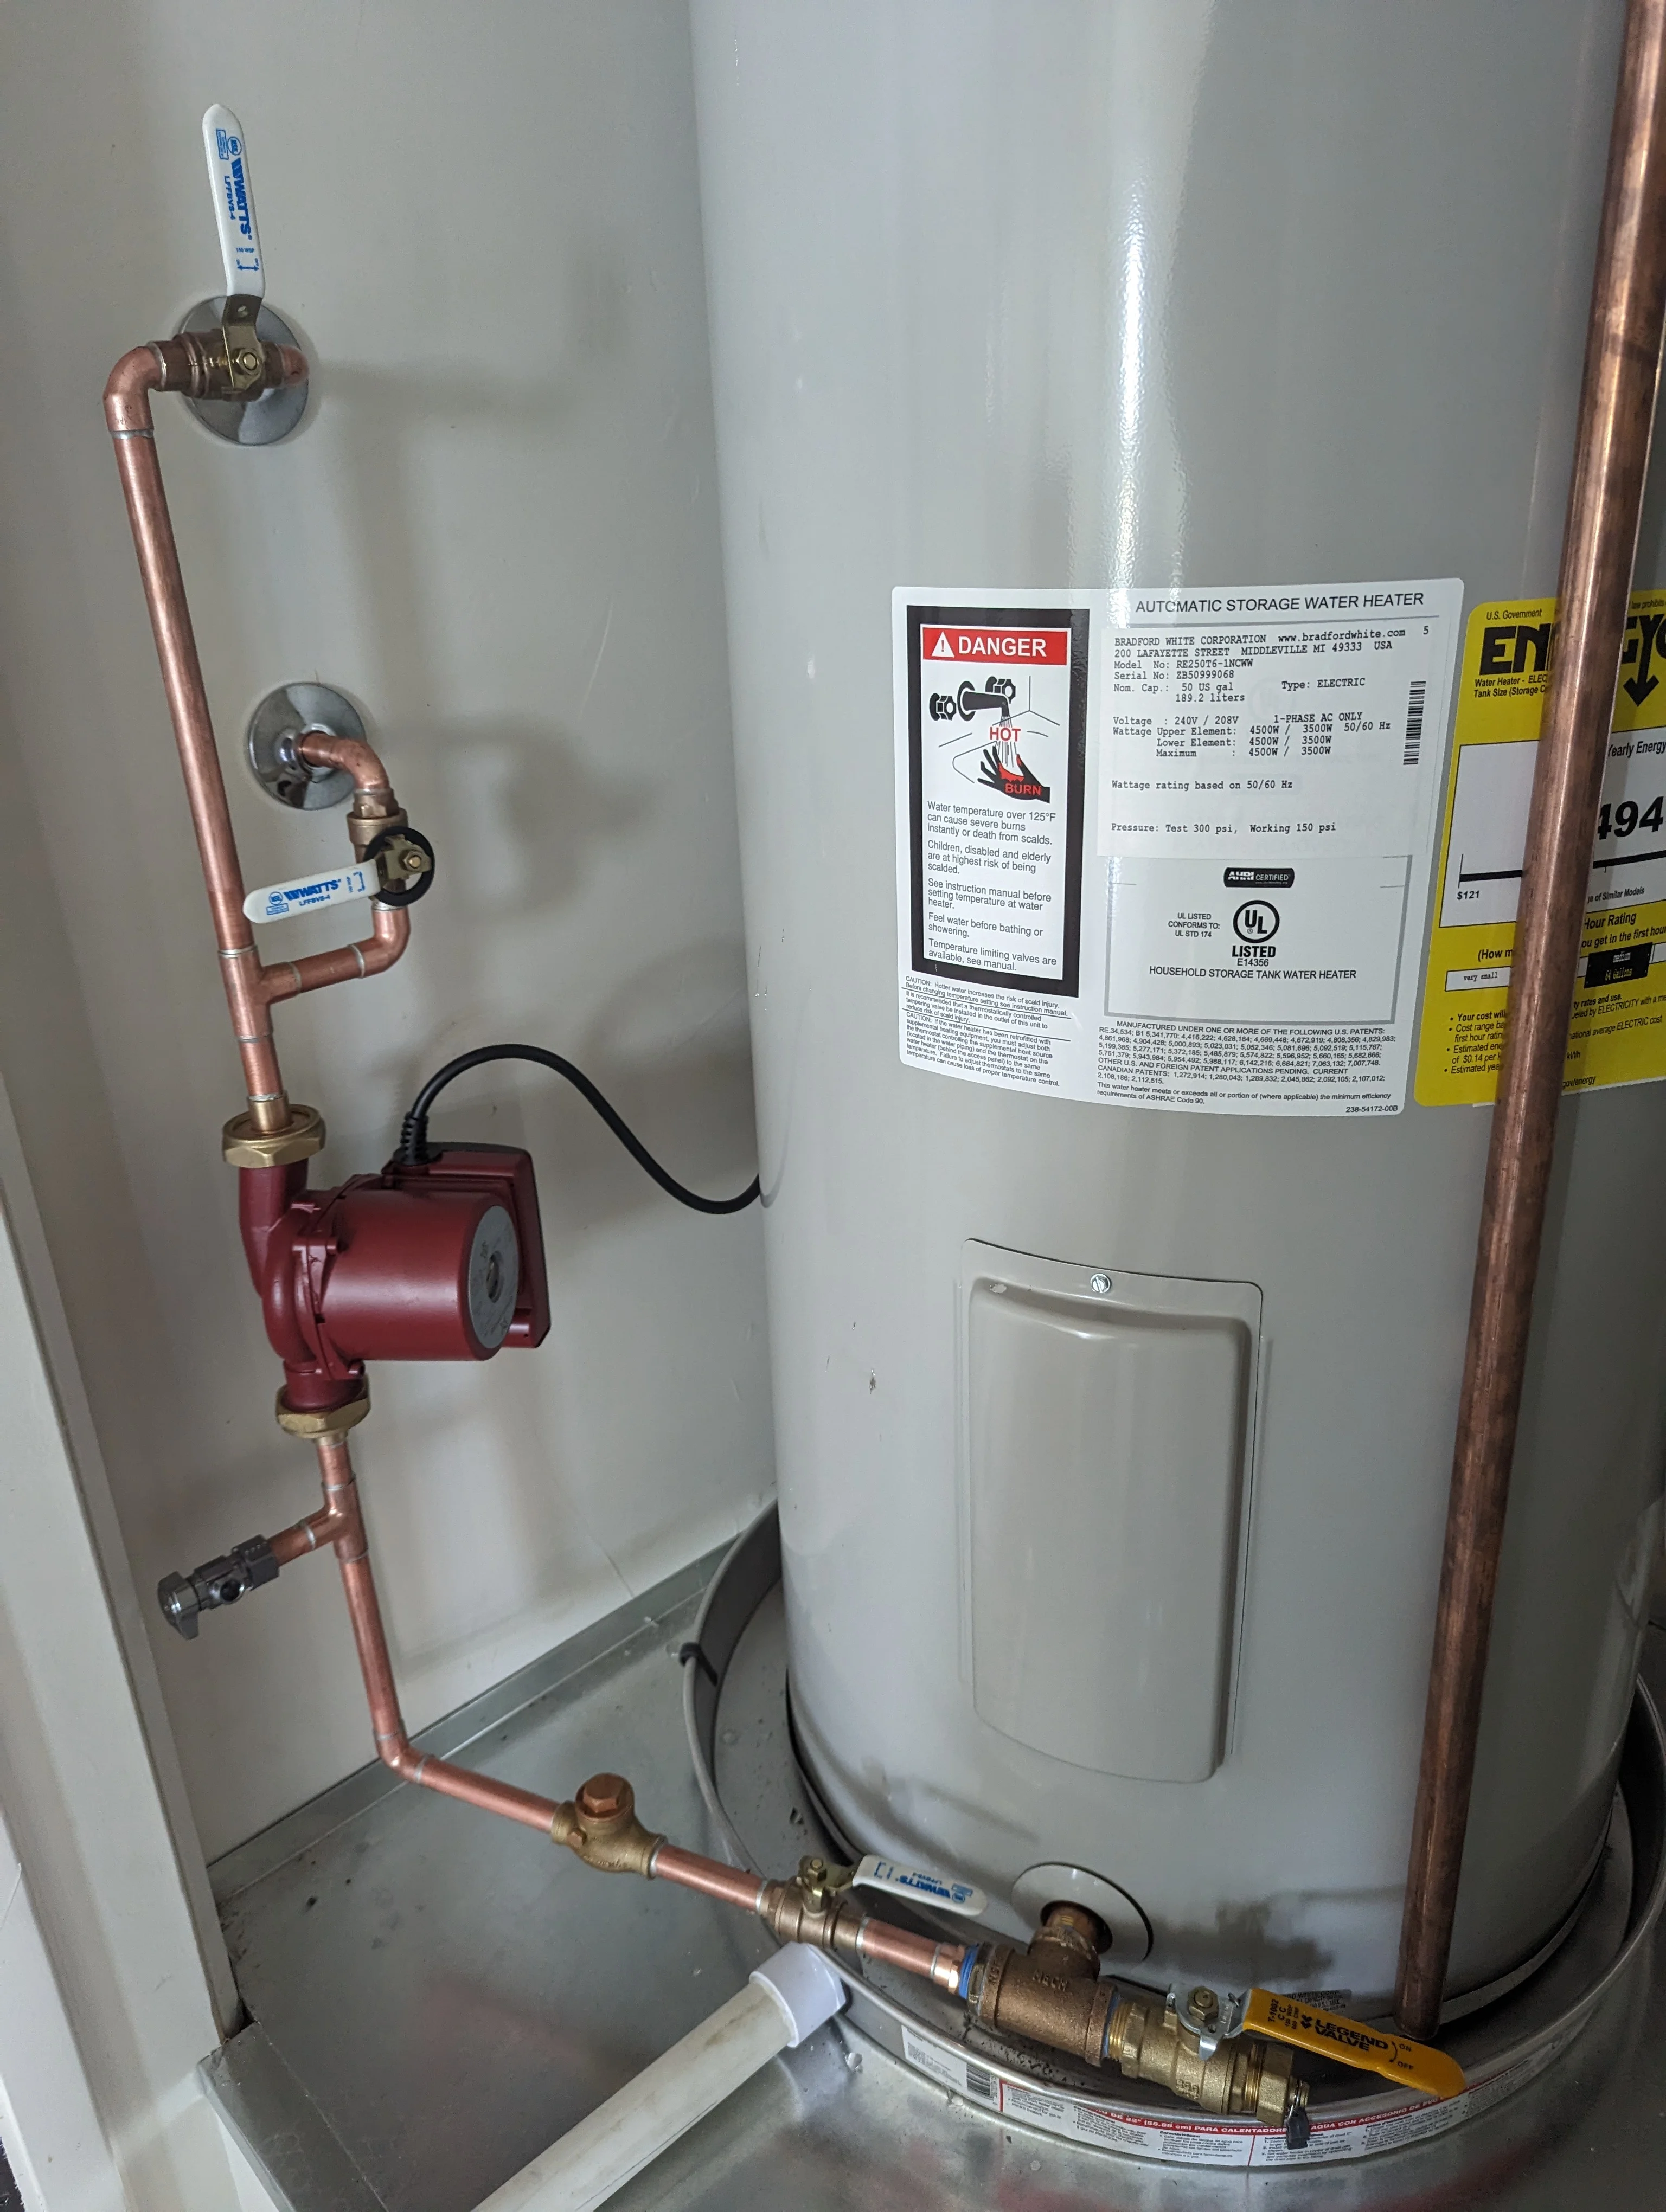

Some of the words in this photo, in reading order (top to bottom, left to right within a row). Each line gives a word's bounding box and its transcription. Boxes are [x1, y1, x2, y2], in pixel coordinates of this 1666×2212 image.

[1136, 599, 1222, 613] AUTOMATIC
[1226, 597, 1300, 612] STORAGE
[1304, 595, 1359, 609] WATER
[1363, 593, 1424, 607] HEATER
[1486, 611, 1501, 620] U.S.
[1503, 608, 1542, 619] Government
[1114, 637, 1160, 646] BRADFORD
[1165, 636, 1195, 646] WHITE
[1200, 634, 1266, 645] CORPORATION
[1278, 629, 1406, 642] www.bradfordwhite.com
[1423, 625, 1429, 635] 5
[958, 635, 1047, 658] DANGER
[1114, 650, 1131, 658] 200
[1137, 648, 1189, 658] LAFAYETTE
[1194, 647, 1229, 657] STREET
[1241, 645, 1308, 655] MIDDLEVILLE
[1313, 644, 1326, 653] MI
[1332, 641, 1362, 652] 49333
[1374, 640, 1393, 650] USA
[1114, 660, 1142, 669] Model
[1153, 660, 1169, 669] No:
[1176, 658, 1254, 669] RE250T6-1NCWW
[1114, 671, 1148, 680] Serial
[1153, 671, 1169, 680] No:
[1176, 670, 1235, 679] ZB50999068
[1475, 678, 1496, 687] Water
[1497, 676, 1520, 686] Heater
[1113, 684, 1135, 692] Nom.
[1141, 684, 1169, 694] Cap.:
[1181, 683, 1193, 692] 50
[1199, 683, 1210, 691] US
[1216, 681, 1234, 693] gal
[1281, 680, 1310, 691] Type:
[1317, 677, 1366, 688] ELECTRIC
[1175, 693, 1204, 703] 189.2
[1209, 693, 1245, 702] liters
[1473, 689, 1491, 698] Tank
[1492, 688, 1507, 697] Size
[1509, 685, 1539, 697] (Storage
[1113, 716, 1152, 727] Voltage
[1174, 716, 1199, 725] 240V
[1214, 715, 1239, 725] 208V
[1273, 713, 1315, 724] 1-PHASE
[1320, 713, 1333, 722] AC
[1338, 711, 1363, 721] ONLY
[989, 726, 1021, 742] HOT
[1112, 726, 1152, 737] Wattage
[1157, 727, 1186, 738] Upper
[1191, 726, 1236, 736] Element:
[1250, 724, 1280, 735] 4500W
[1302, 723, 1333, 734] 3500W
[1343, 721, 1374, 733] 50/60
[1379, 721, 1391, 730] Hz
[1156, 738, 1186, 747] Lower
[1190, 737, 1236, 747] Element:
[1249, 736, 1279, 746] 4500W
[1302, 735, 1332, 745] 3500W
[1156, 748, 1197, 757] Maximum
[1248, 747, 1278, 756] 4500W
[1301, 745, 1331, 756] 3500W
[1004, 783, 1042, 796] BURN
[1112, 780, 1150, 790] Wattage
[1155, 781, 1190, 792] rating
[1194, 780, 1224, 789] based
[1246, 779, 1276, 790] 50/60
[1281, 780, 1293, 789] Hz
[927, 800, 951, 813] Water
[953, 803, 1003, 819] temperature
[1006, 812, 1026, 820] over
[927, 814, 941, 822] can
[944, 816, 968, 826] cause
[970, 819, 999, 829] severe
[1001, 821, 1026, 832] burns
[1111, 823, 1159, 832] Pressure:
[1165, 824, 1188, 833] Test
[1193, 824, 1210, 833] 300
[1215, 825, 1238, 835] psi,
[1250, 824, 1291, 834] Working
[1296, 823, 1313, 832] 150
[1318, 822, 1336, 834] psi
[927, 824, 960, 838] instantly
[962, 829, 971, 837] or
[972, 829, 997, 840] death
[998, 832, 1018, 843] from
[1021, 834, 1053, 845] scalds.
[927, 840, 963, 854] Children,
[965, 845, 1000, 858] disabled
[1002, 849, 1019, 860] and
[1021, 851, 1051, 865] elderly
[928, 878, 944, 889] See
[945, 881, 986, 895] instruction
[989, 888, 1021, 899] manual
[1023, 892, 1052, 903] before
[1457, 890, 1480, 900] $121
[1624, 886, 1645, 897] Models
[1168, 921, 1207, 929] CONFORMS
[1244, 909, 1267, 934] UL
[1607, 912, 1637, 926] Rating
[1619, 931, 1632, 942] the
[1633, 928, 1649, 940] first
[1232, 945, 1276, 958] LISTED
[1236, 958, 1269, 967] E14356
[1149, 966, 1207, 978] HOUSEHOLD
[1208, 968, 1254, 980] STORAGE
[1255, 969, 1281, 980] TANK
[1283, 970, 1317, 980] WATER
[1318, 969, 1357, 980] HEATER
[1463, 974, 1477, 982] very
[1481, 972, 1498, 980] small
[906, 976, 932, 987] CAUTION:
[968, 989, 995, 999] increases
[1457, 1012, 1476, 1022] Your
[1477, 1012, 1492, 1020] cost
[1116, 1020, 1176, 1031] MANUFACTURED
[1315, 2018, 1389, 2049] LEGEND
[1315, 2025, 1369, 2052] VALVE
[1399, 2043, 1412, 2052] ON
[1398, 2061, 1414, 2070] OFF
